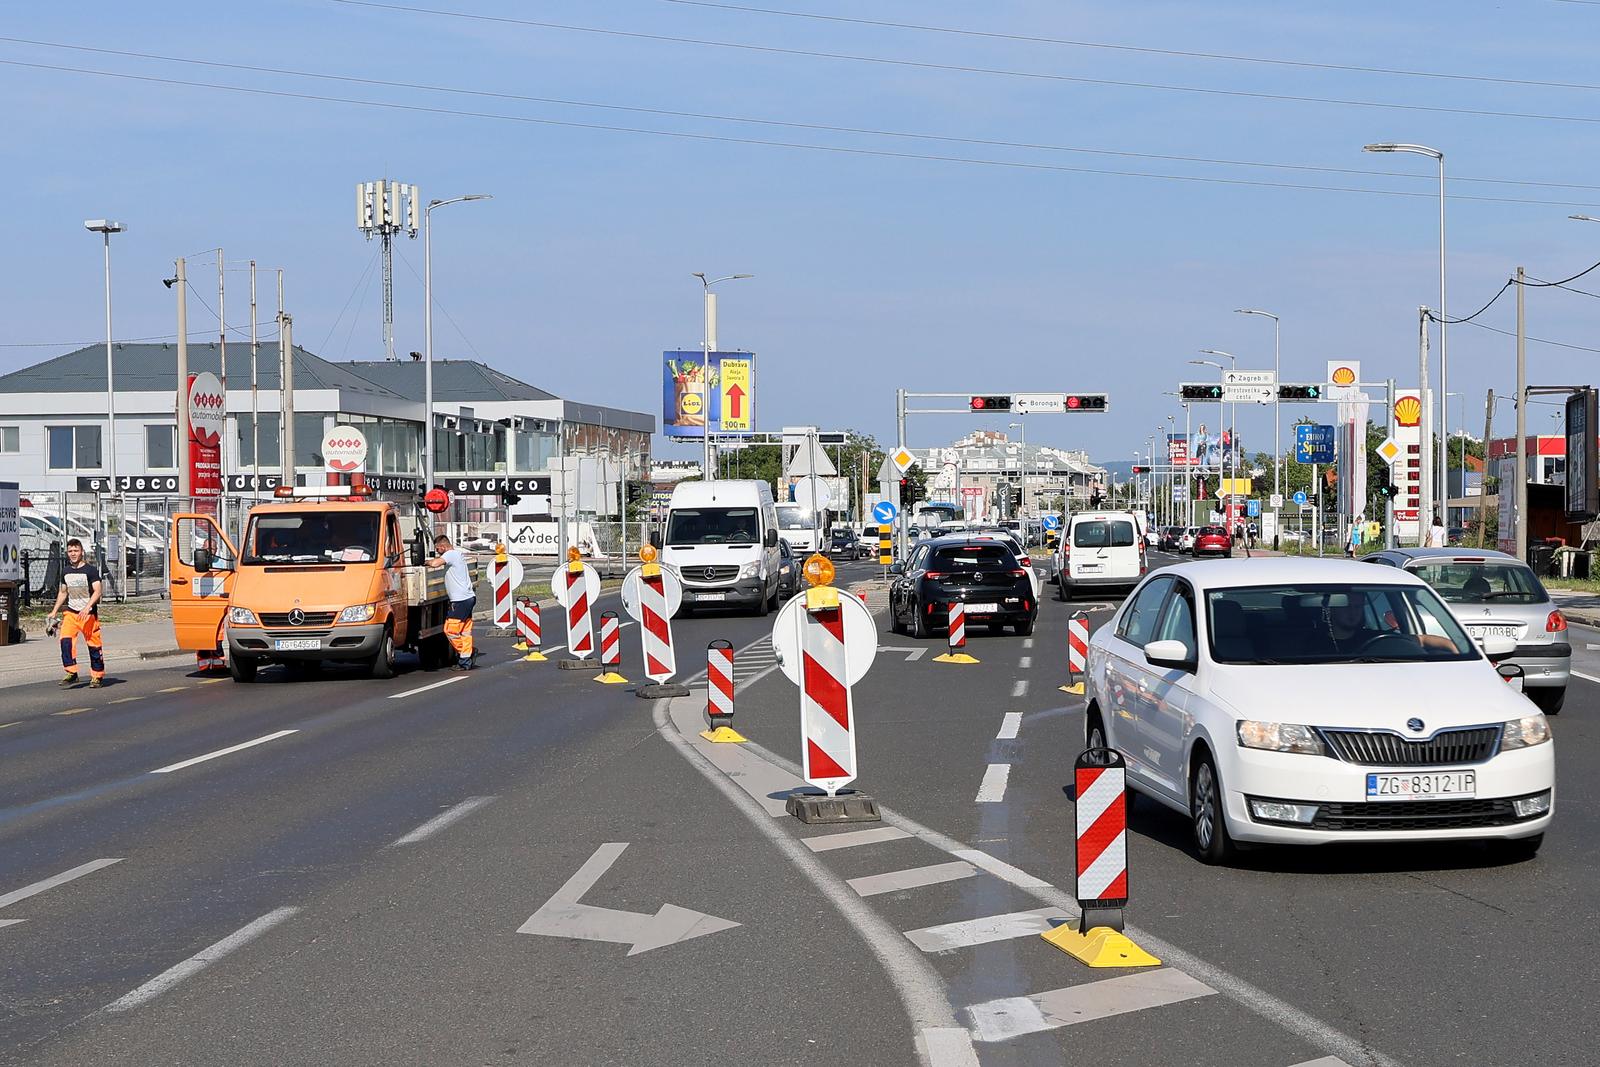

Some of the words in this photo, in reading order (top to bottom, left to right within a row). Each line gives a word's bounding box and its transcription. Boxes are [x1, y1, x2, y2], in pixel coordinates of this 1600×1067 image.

[1305, 433, 1325, 441] EURO
[1302, 441, 1327, 455] Spin
[387, 477, 415, 490] evdeco
[1380, 777, 1400, 794] ZG
